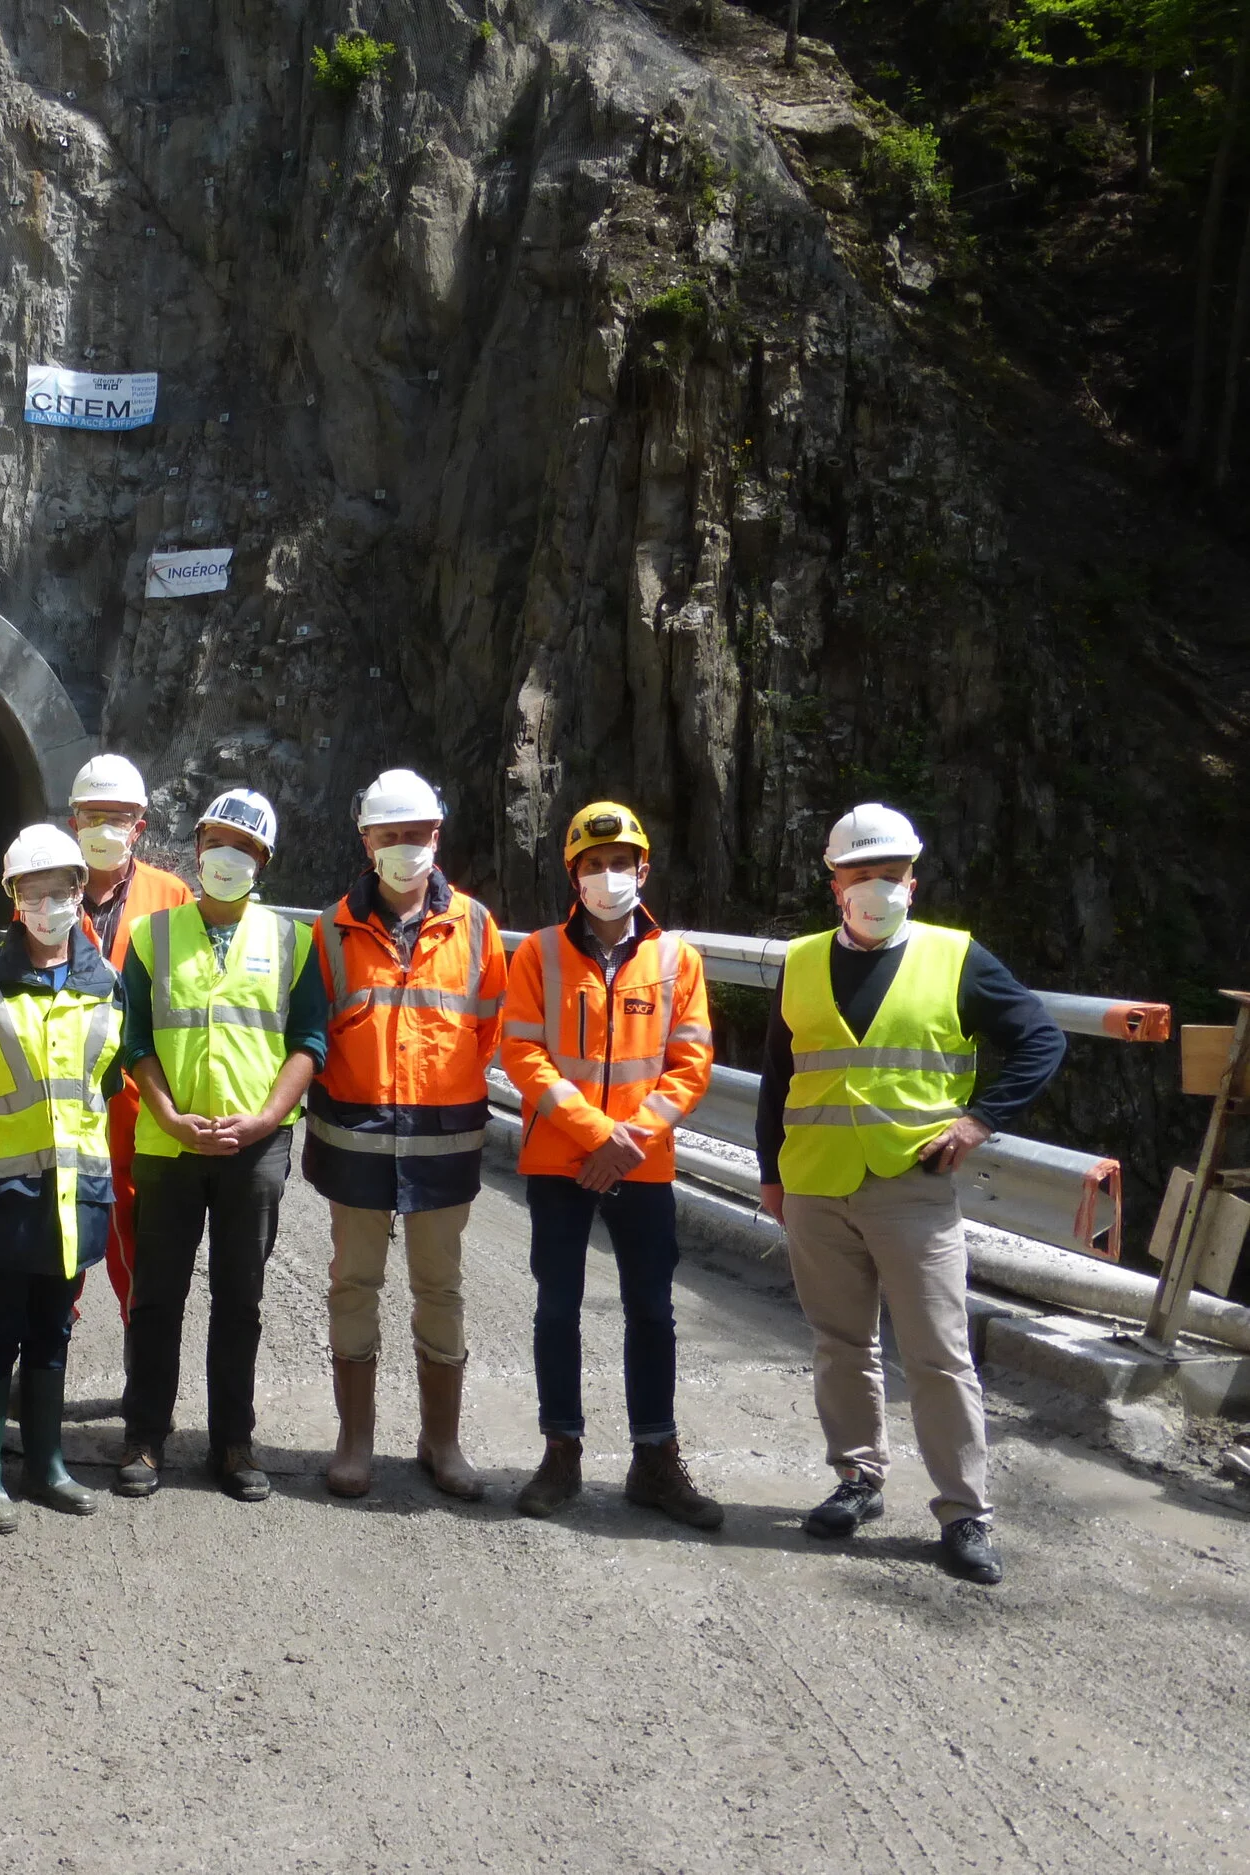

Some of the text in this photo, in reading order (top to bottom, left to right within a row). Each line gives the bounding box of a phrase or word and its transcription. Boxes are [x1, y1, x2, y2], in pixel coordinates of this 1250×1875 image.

[31, 393, 130, 418] CITEM
[30, 411, 70, 424] TRAVAUX
[625, 1004, 653, 1014] SNCF
